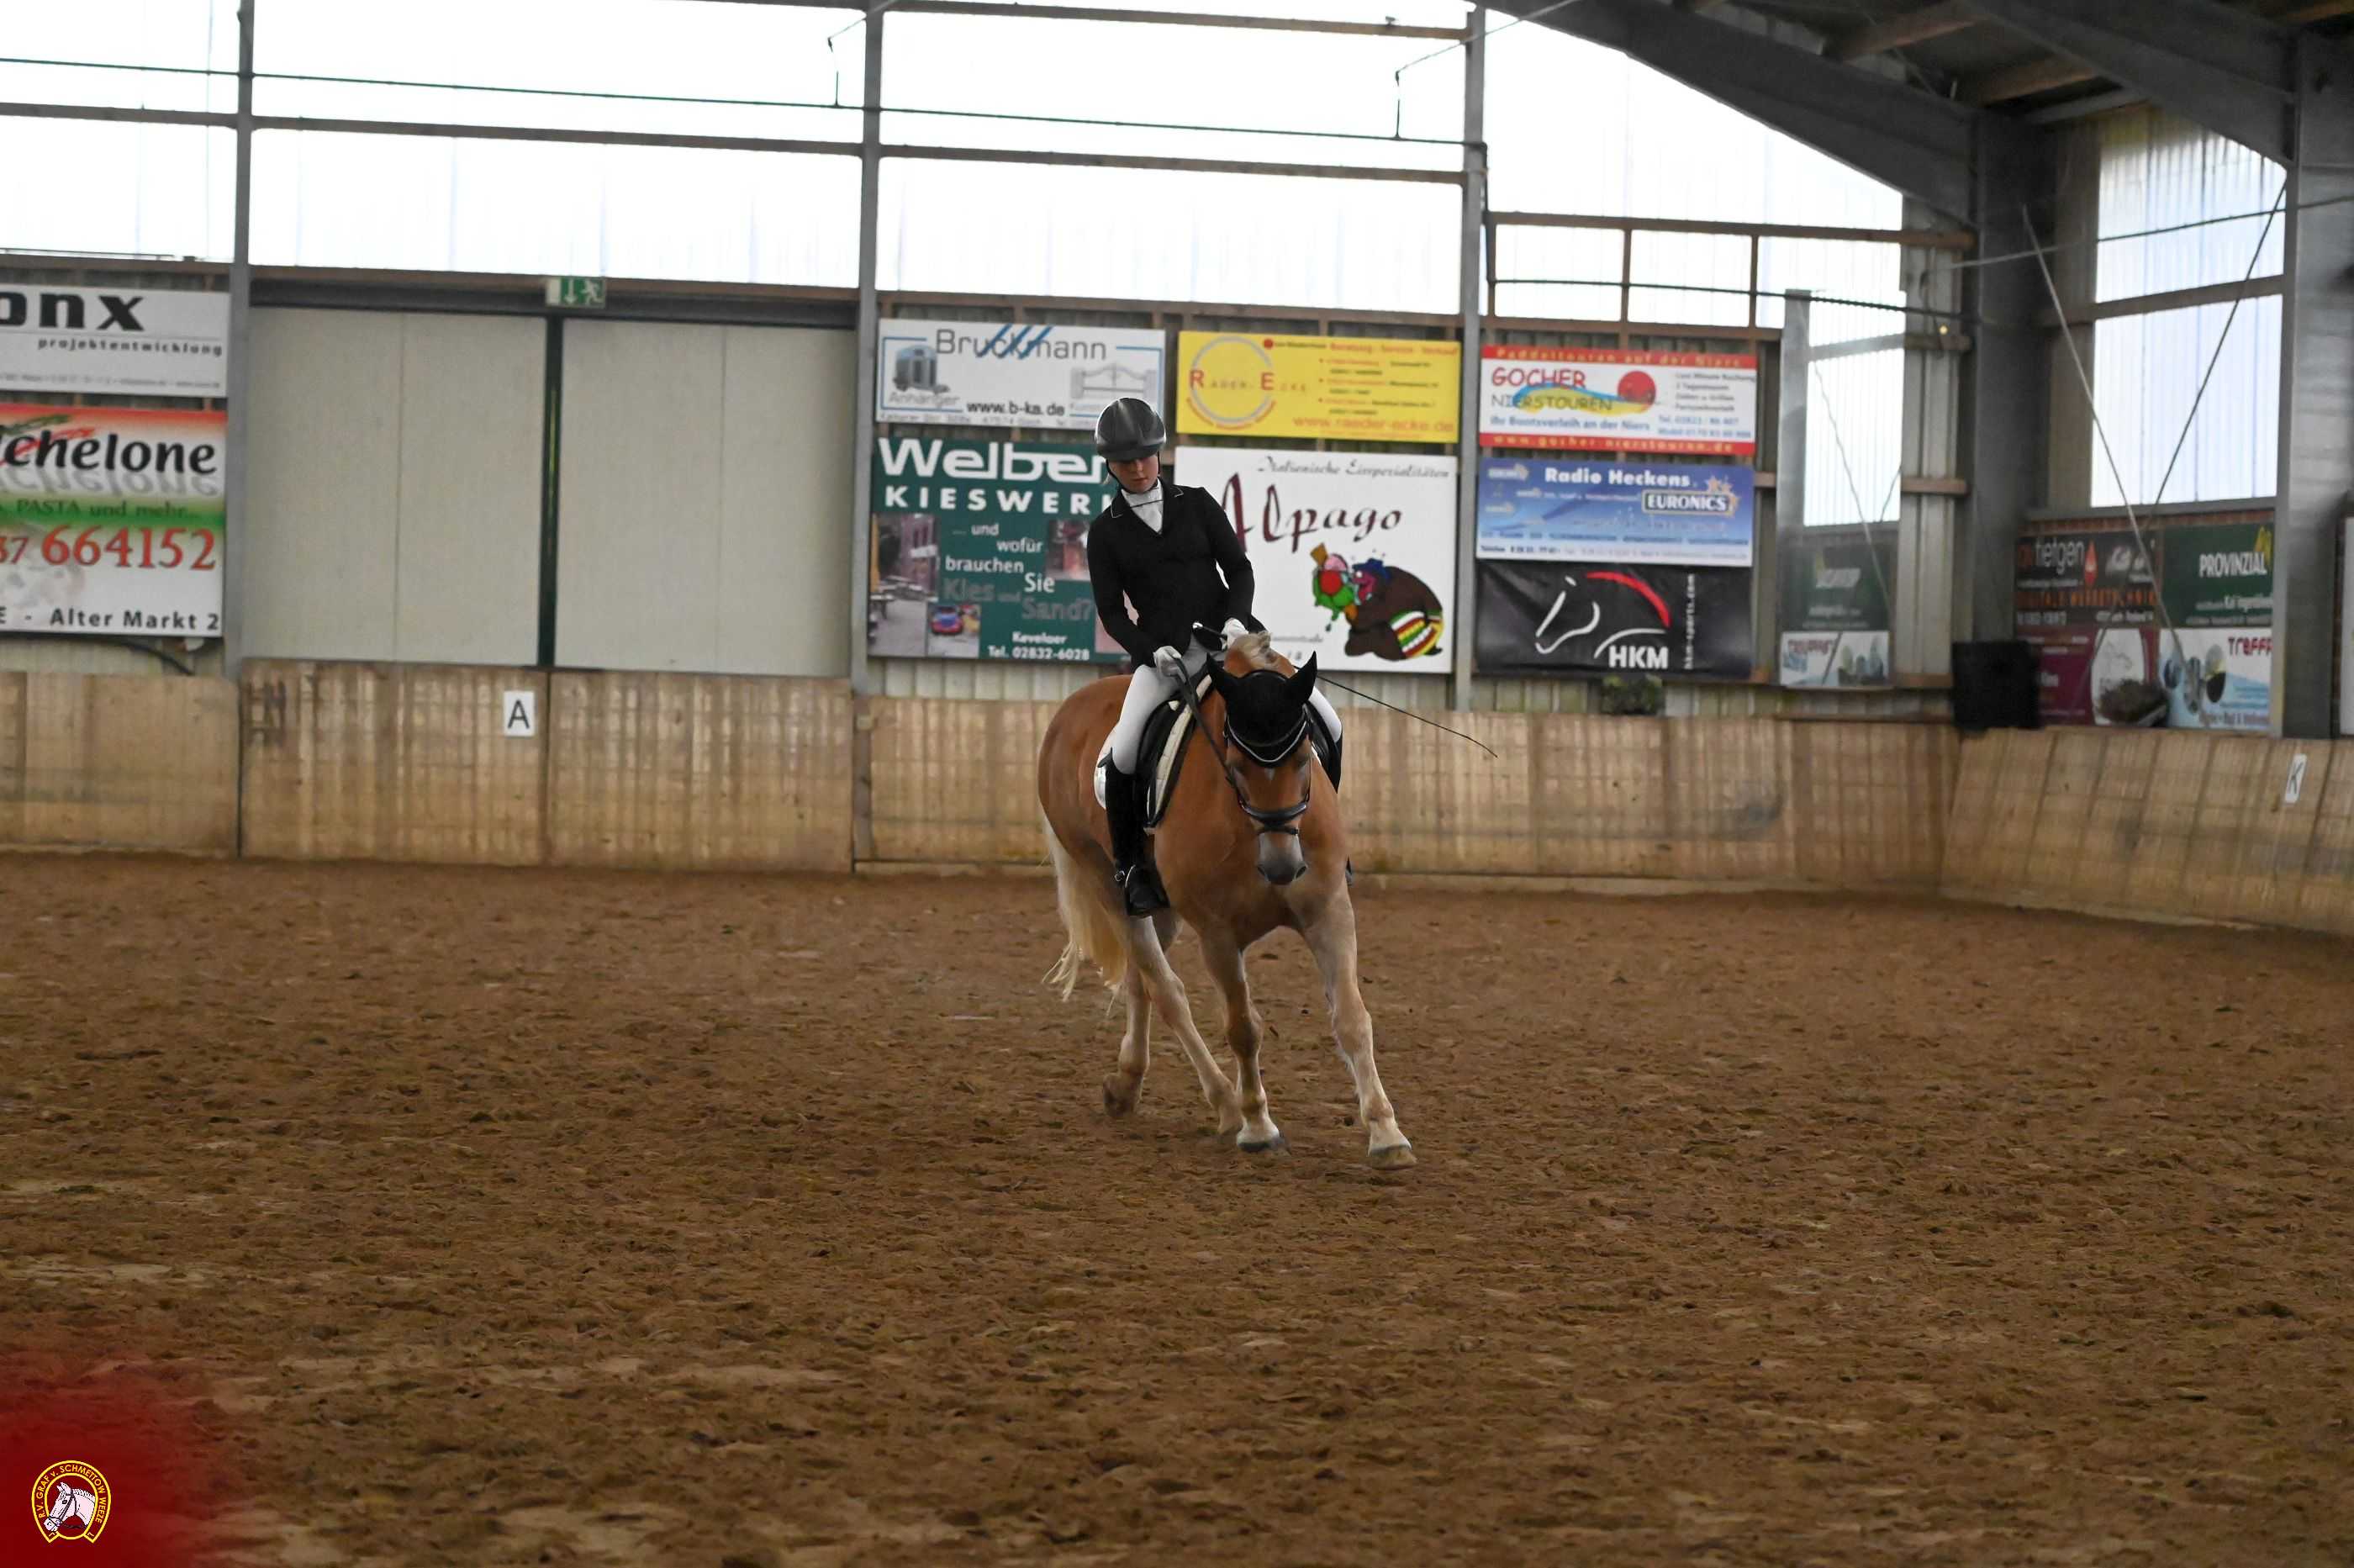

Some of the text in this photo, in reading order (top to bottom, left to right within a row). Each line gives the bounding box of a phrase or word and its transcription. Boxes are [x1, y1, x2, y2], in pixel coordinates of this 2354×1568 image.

[38, 338, 223, 356] projektentwicklung
[1660, 353, 1686, 364] der
[1491, 367, 1587, 389] GOCHER
[967, 400, 1066, 416] www.b-ka.de
[1491, 393, 1613, 411] NIERSTOUREN
[1600, 419, 1618, 429] der
[0, 428, 218, 475] chelone
[879, 438, 1107, 484] Welber
[1544, 467, 1691, 487] Radio Heckens
[17, 499, 82, 515] PASTA
[89, 501, 127, 517] und
[1222, 472, 1401, 554] Alpago
[1647, 494, 1727, 512] EURONICS
[971, 523, 1000, 536] und
[42, 524, 217, 572] 664152
[996, 537, 1043, 553] wofür
[945, 555, 1025, 573] brauchen
[2198, 551, 2268, 578] PROVINZIAL
[943, 578, 996, 602] Kies
[1024, 573, 1056, 594] Sie
[1021, 595, 1093, 621] Sand?
[50, 607, 113, 626] Alter
[123, 610, 198, 631] Markt
[207, 613, 219, 631] 2
[987, 646, 1090, 661] Tel. 02832-6028
[1609, 645, 1669, 670] HKM
[507, 699, 530, 730] A
[2288, 761, 2304, 795] K
